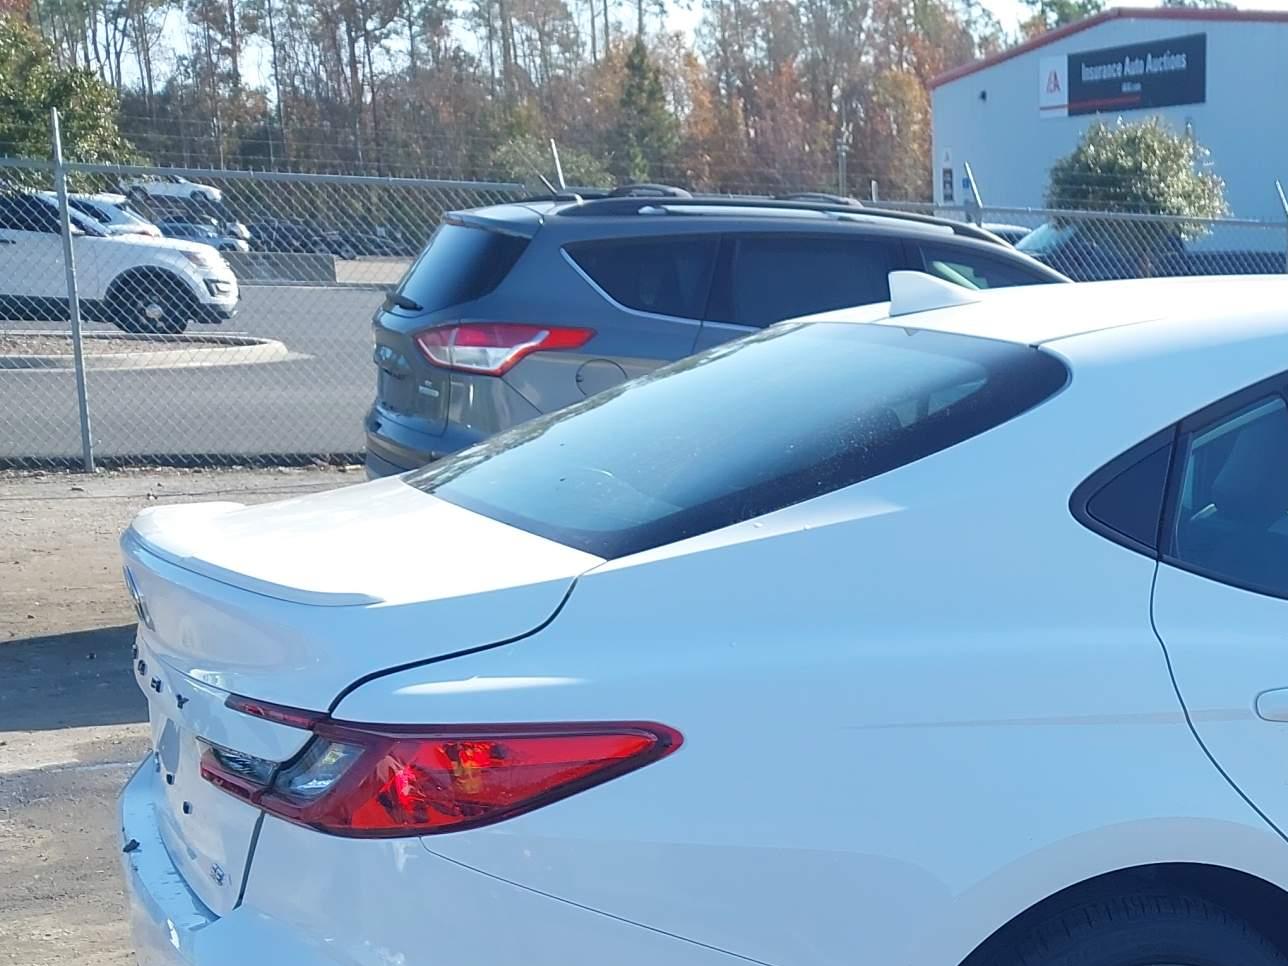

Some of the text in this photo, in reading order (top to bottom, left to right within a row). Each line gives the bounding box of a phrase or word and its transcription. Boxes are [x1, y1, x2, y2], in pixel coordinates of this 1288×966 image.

[1081, 61, 1123, 81] Insurance
[1123, 55, 1144, 76] Auto
[1145, 50, 1187, 73] Auctions
